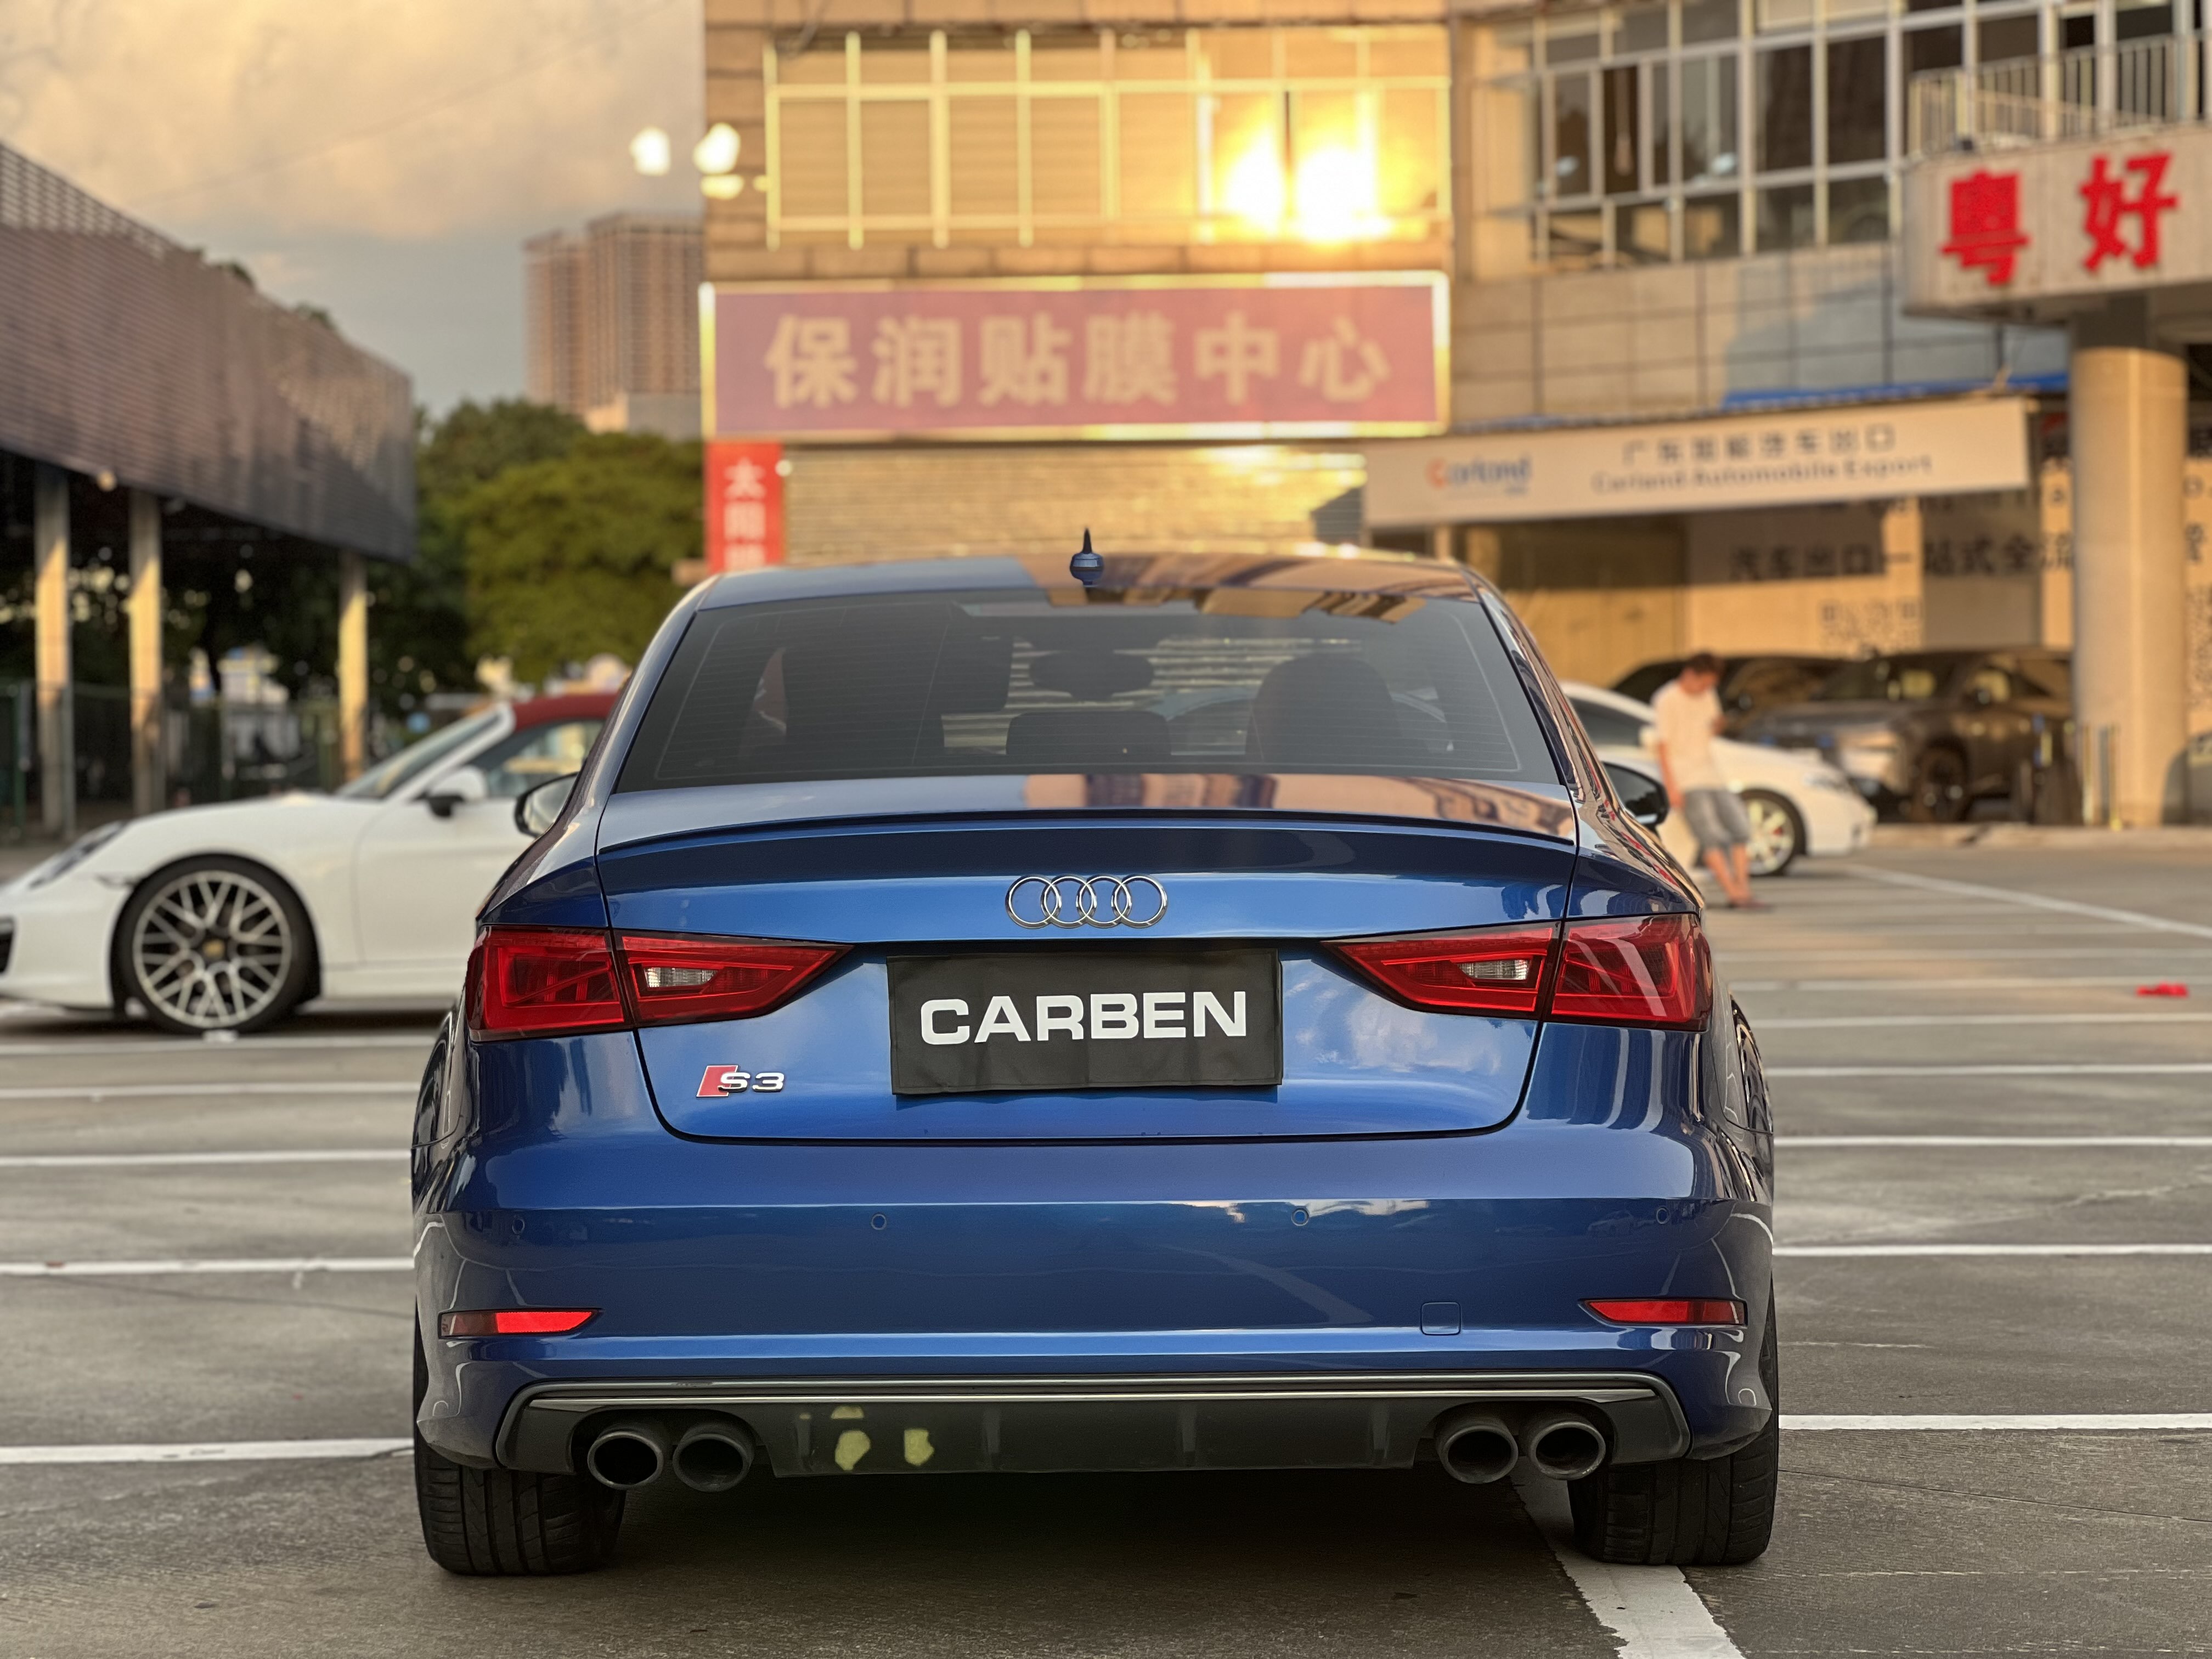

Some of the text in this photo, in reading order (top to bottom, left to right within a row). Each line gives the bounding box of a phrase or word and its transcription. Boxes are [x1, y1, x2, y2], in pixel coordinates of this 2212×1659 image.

[1938, 153, 2180, 287] 粤好
[765, 311, 1392, 409] 保润贴膜中心
[1692, 461, 1839, 487] Automobile
[1844, 455, 1933, 481] Export
[921, 991, 1247, 1045] CARBEN
[718, 1072, 785, 1093] S3
